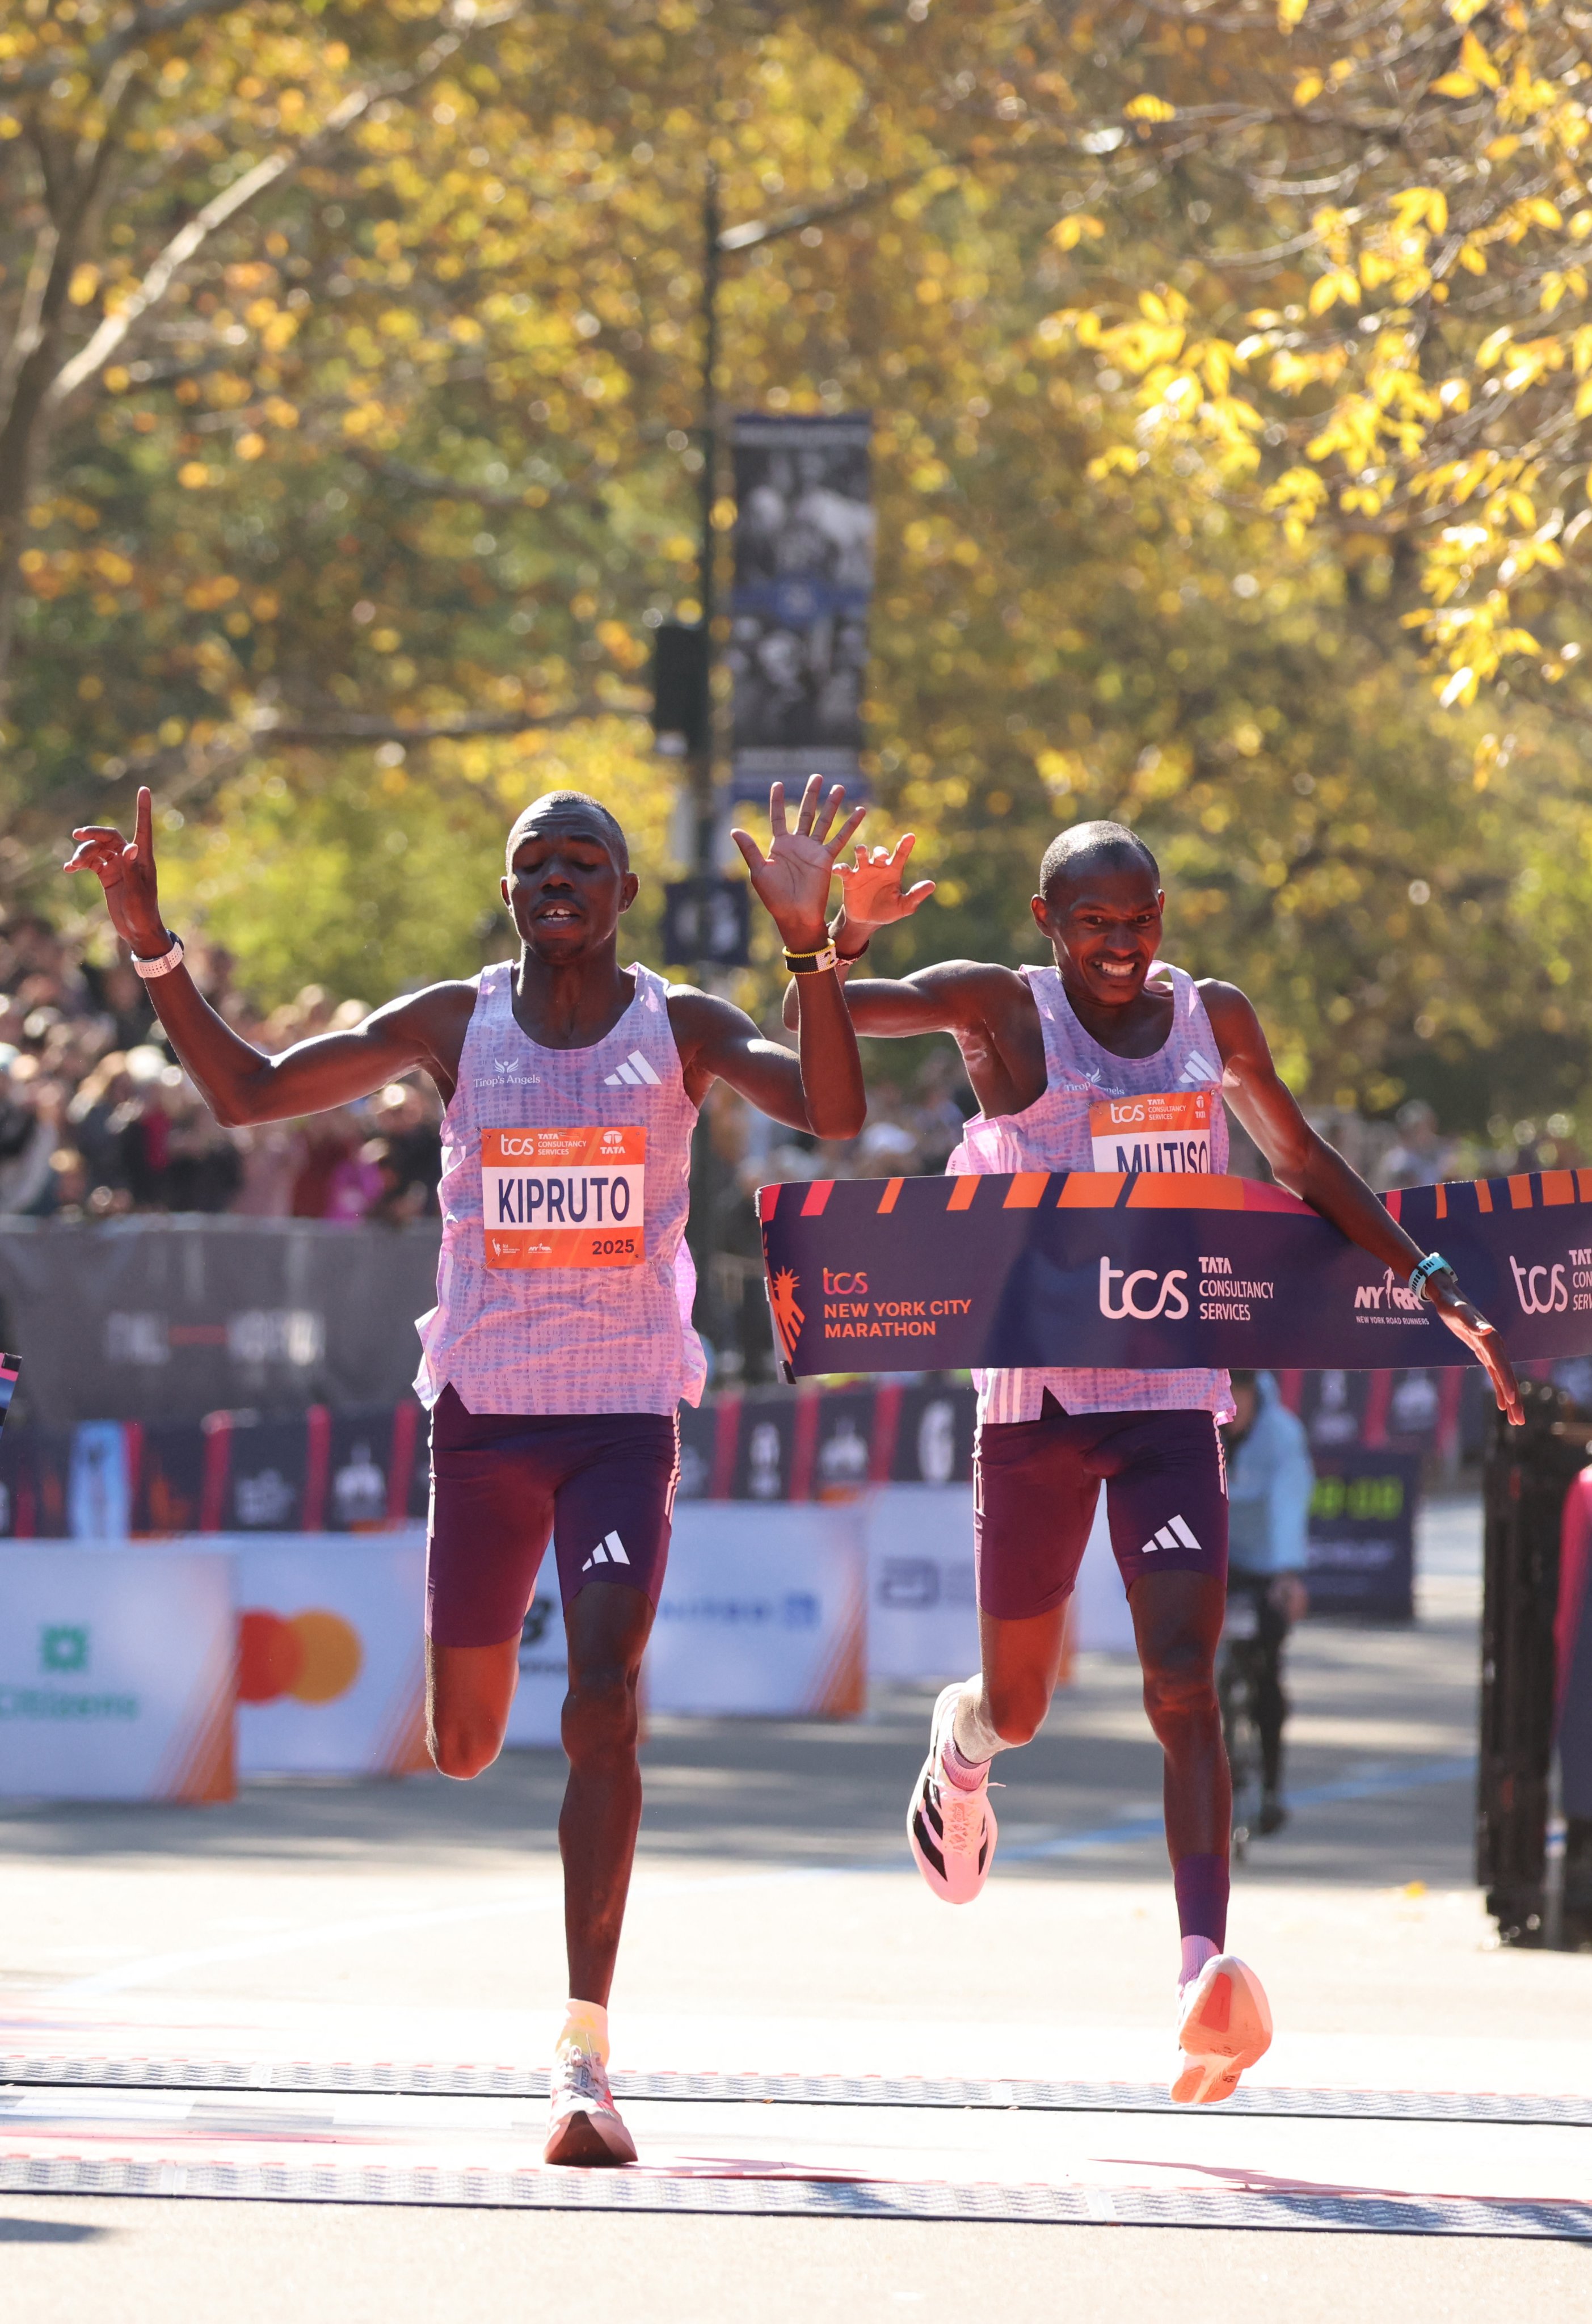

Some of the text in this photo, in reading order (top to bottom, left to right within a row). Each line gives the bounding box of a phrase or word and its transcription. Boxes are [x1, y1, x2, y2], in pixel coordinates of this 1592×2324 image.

[473, 1074, 541, 1088] Tirop's Angels
[1110, 1103, 1145, 1123] tcs
[500, 1134, 534, 1156] tcs
[498, 1176, 630, 1223] KIPRUTO
[592, 1239, 635, 1255] 2025
[1198, 1256, 1233, 1274] TATA
[823, 1267, 869, 1295] tcs
[1099, 1256, 1189, 1319] tcs
[1199, 1279, 1274, 1299] CONSULTANCY
[1509, 1255, 1568, 1315] tcs
[824, 1299, 972, 1319] NEW YORK CITY
[1199, 1303, 1251, 1321] SERVICES
[824, 1321, 936, 1338] MARATHON
